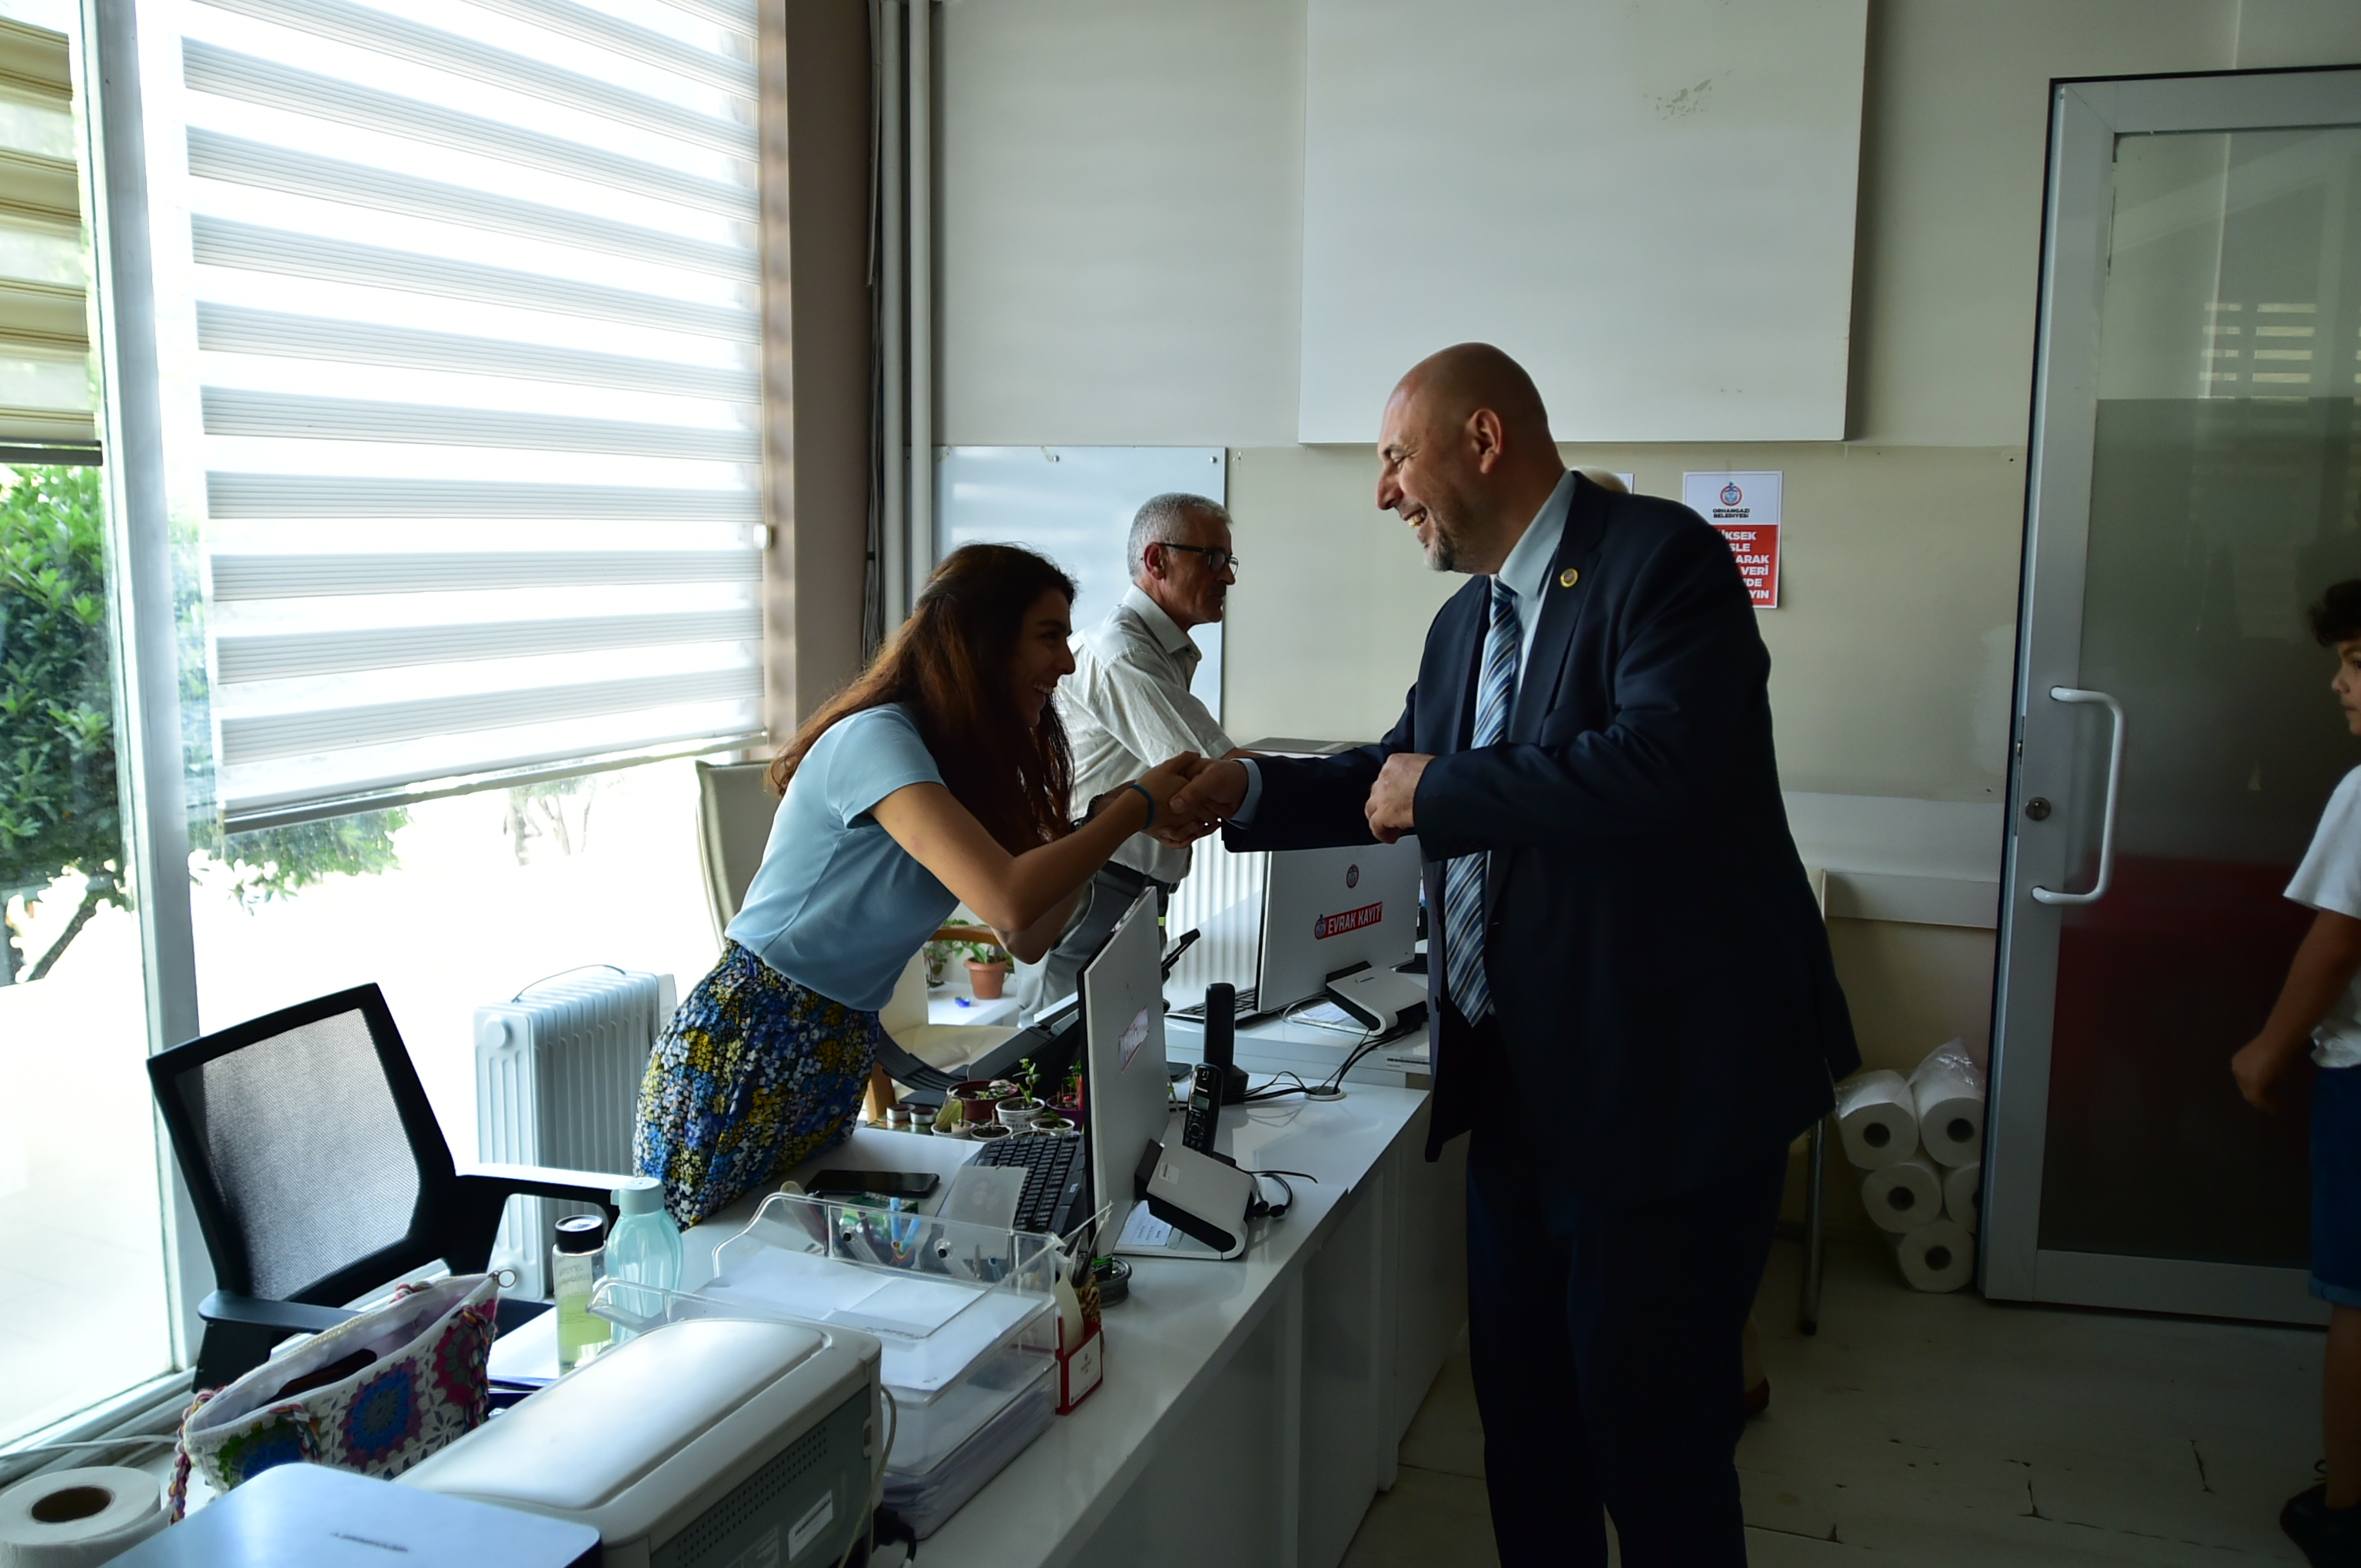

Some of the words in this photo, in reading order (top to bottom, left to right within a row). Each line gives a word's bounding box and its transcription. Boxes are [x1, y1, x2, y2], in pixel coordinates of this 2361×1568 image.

[1721, 529, 1757, 540] KSEK
[1729, 543, 1751, 552] SLE
[1735, 555, 1769, 563] ARAK
[1328, 912, 1356, 935] EVRAK
[1358, 905, 1381, 926] KAYIT
